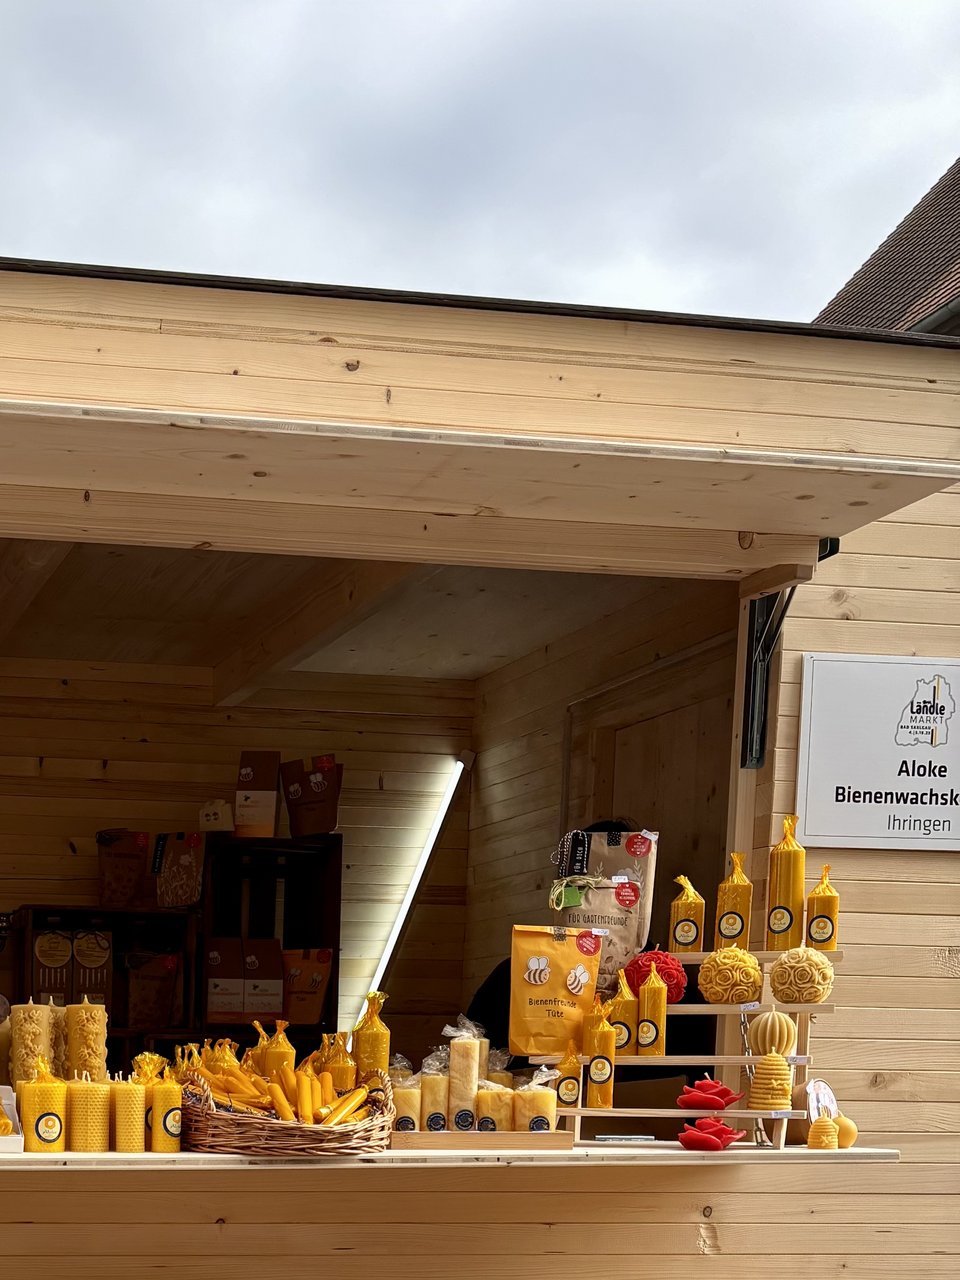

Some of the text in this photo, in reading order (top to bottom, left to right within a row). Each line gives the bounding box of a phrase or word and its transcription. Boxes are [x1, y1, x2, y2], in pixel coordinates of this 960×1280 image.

[910, 692, 945, 715] Ländle
[910, 715, 944, 724] MARKT
[897, 760, 948, 778] Aloke
[835, 786, 960, 806] Bienenwachsk
[887, 814, 951, 835] Ihringen
[569, 913, 628, 927] FÜR GARTENFREUNDE
[545, 1009, 564, 1018] Tüte
